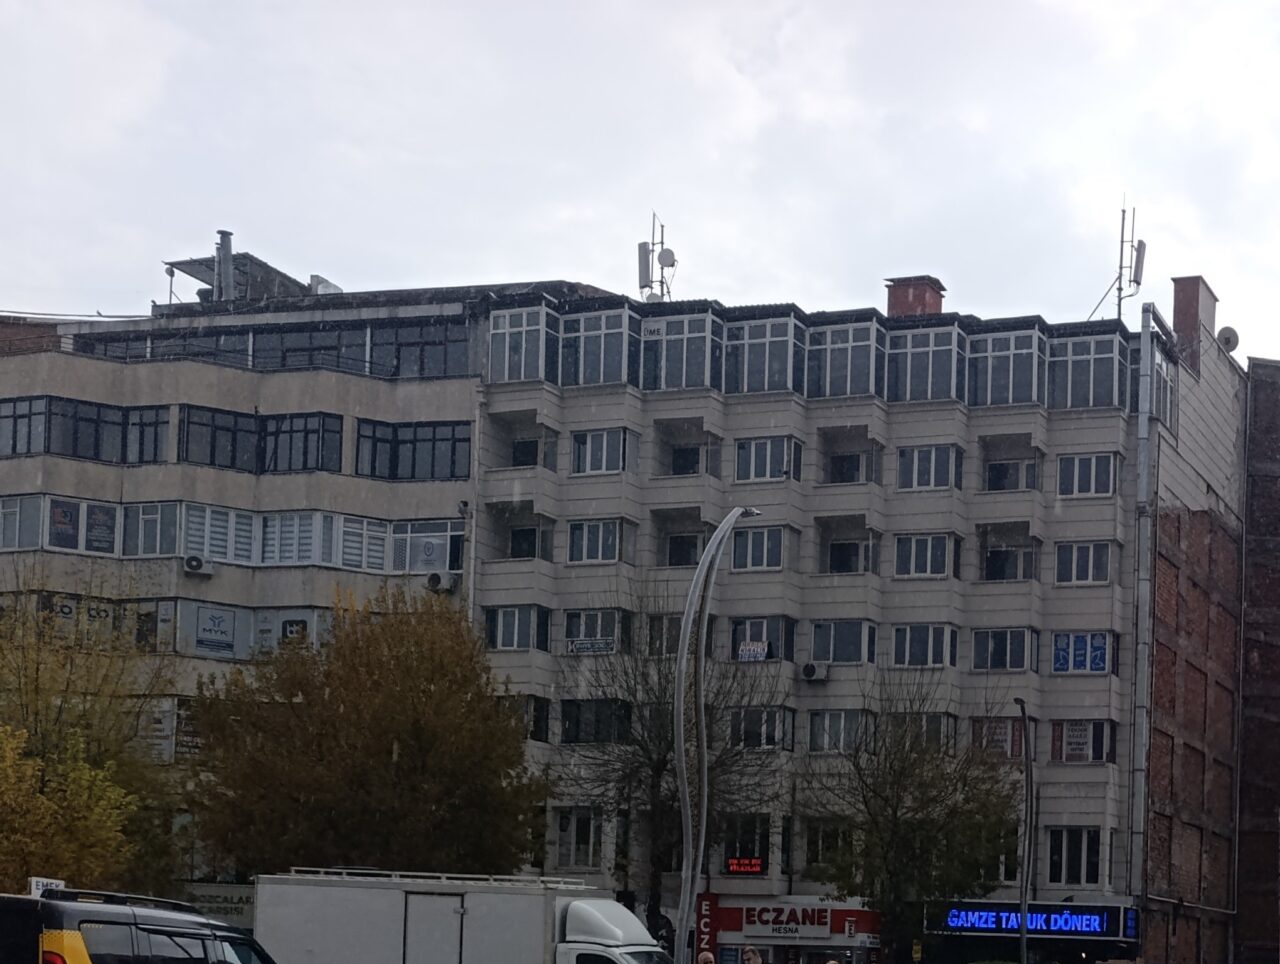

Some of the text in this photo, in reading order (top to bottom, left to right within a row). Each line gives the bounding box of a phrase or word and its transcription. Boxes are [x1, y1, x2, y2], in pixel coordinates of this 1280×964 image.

[202, 626, 228, 638] MYK
[745, 906, 829, 926] ECZANE
[947, 909, 995, 929] GAMZE
[1050, 910, 1105, 933] DÖNER
[771, 926, 799, 935] HESNA
